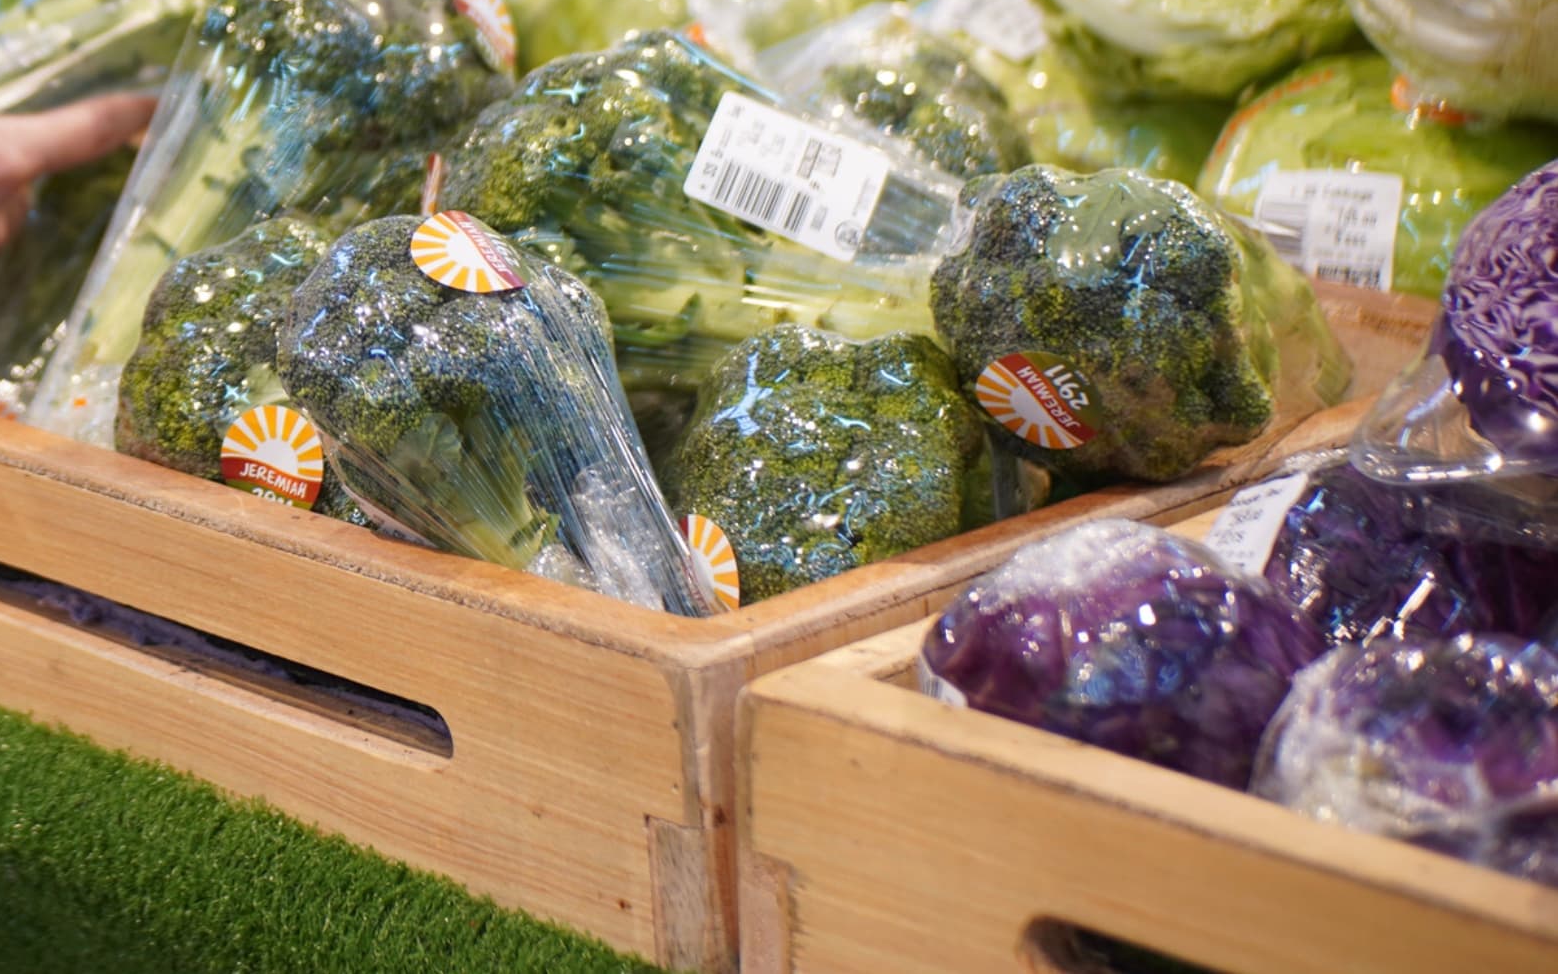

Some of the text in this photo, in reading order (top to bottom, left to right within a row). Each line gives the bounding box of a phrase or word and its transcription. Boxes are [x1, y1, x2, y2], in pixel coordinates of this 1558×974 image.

[458, 221, 513, 275] JEREMIAH
[1016, 365, 1081, 428] JEREMIAH
[1043, 364, 1090, 410] 2911
[240, 462, 308, 498] JEREMIAH
